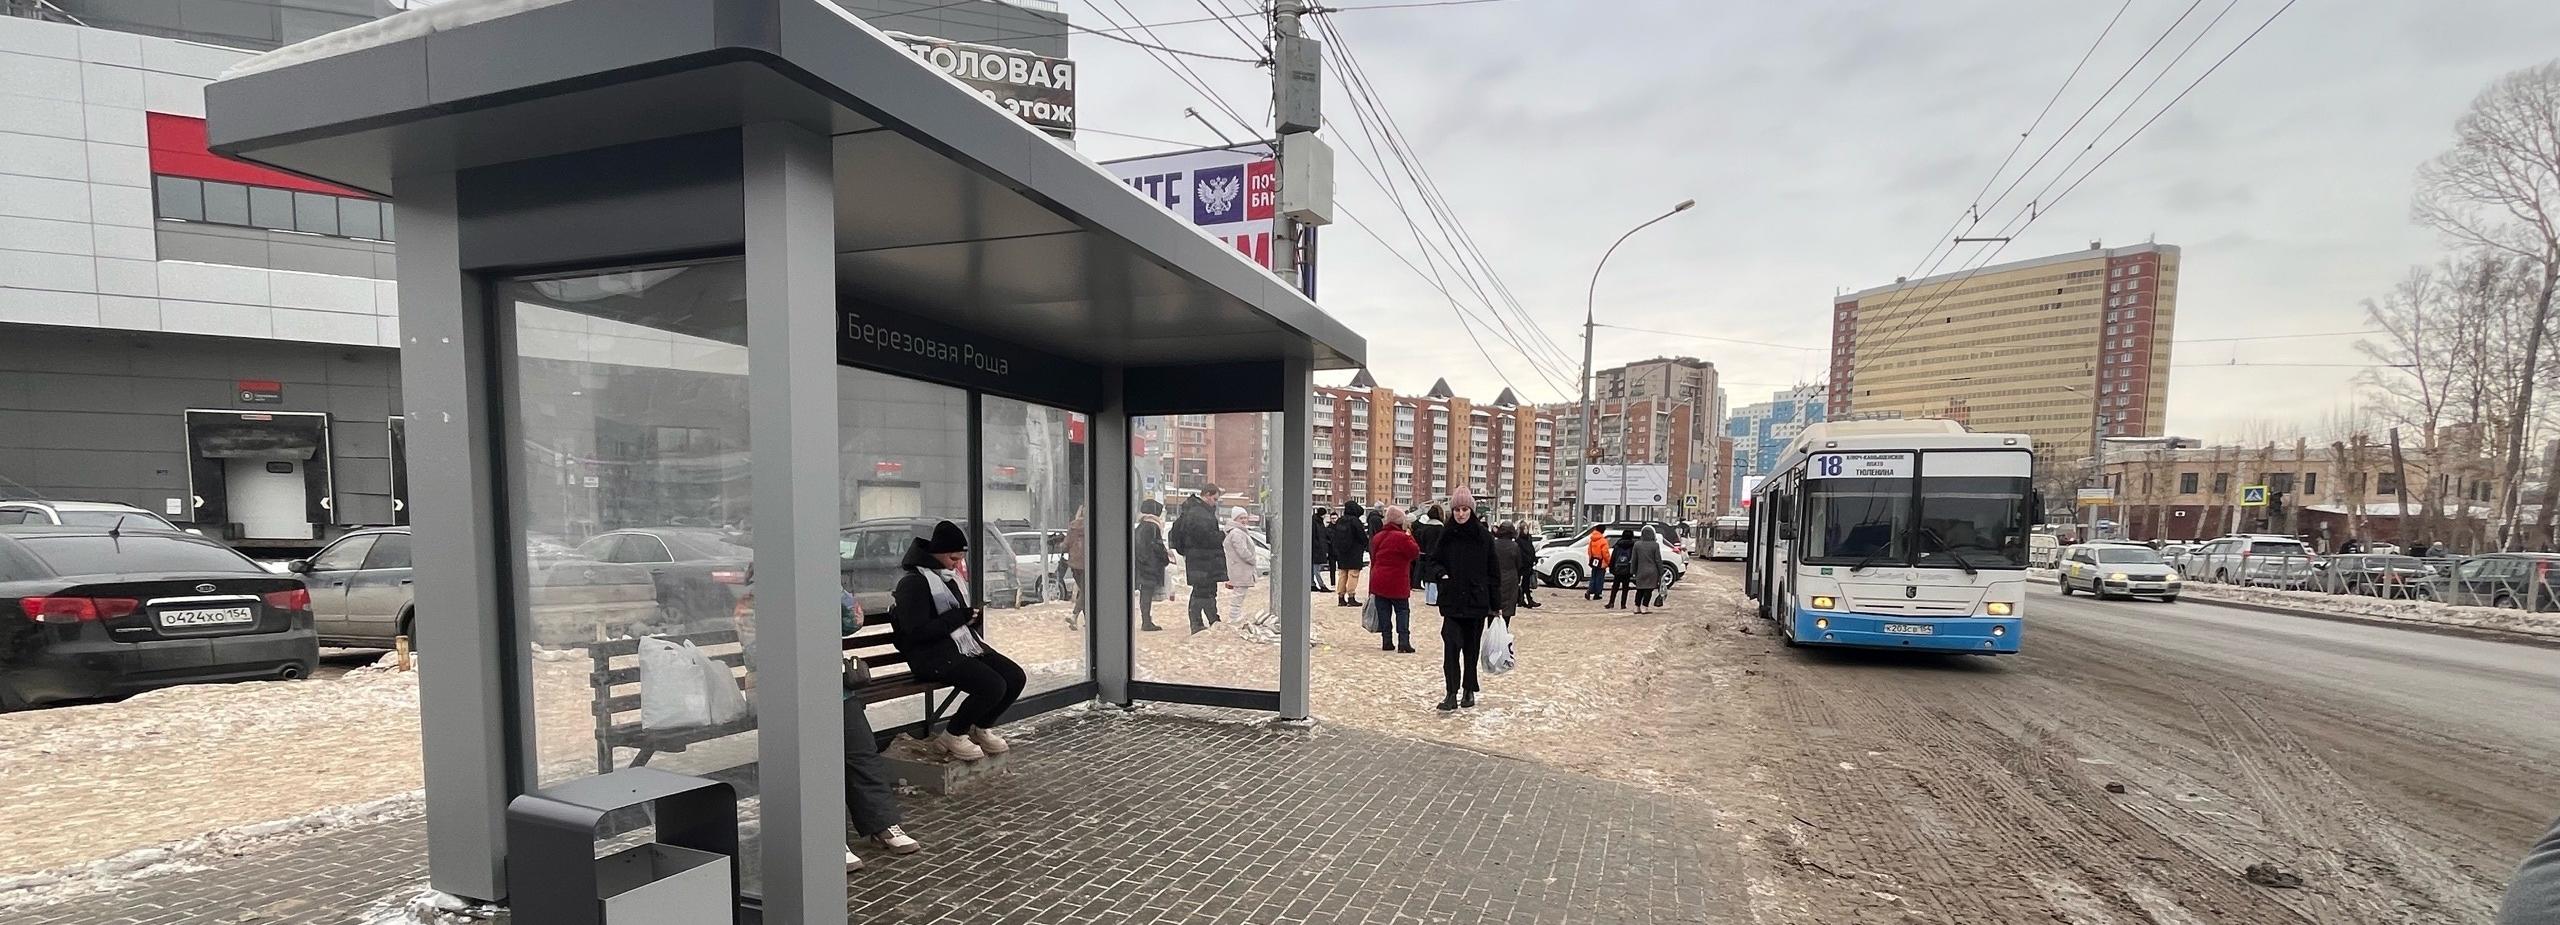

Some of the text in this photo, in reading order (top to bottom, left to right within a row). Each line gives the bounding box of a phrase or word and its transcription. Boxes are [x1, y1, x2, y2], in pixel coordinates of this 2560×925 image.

[895, 41, 1072, 91] ТОЛОВАЯ
[1004, 98, 1073, 122] этаж
[849, 313, 1008, 376] Березовая Роща
[1818, 455, 1842, 476] 18
[227, 609, 248, 618] 154
